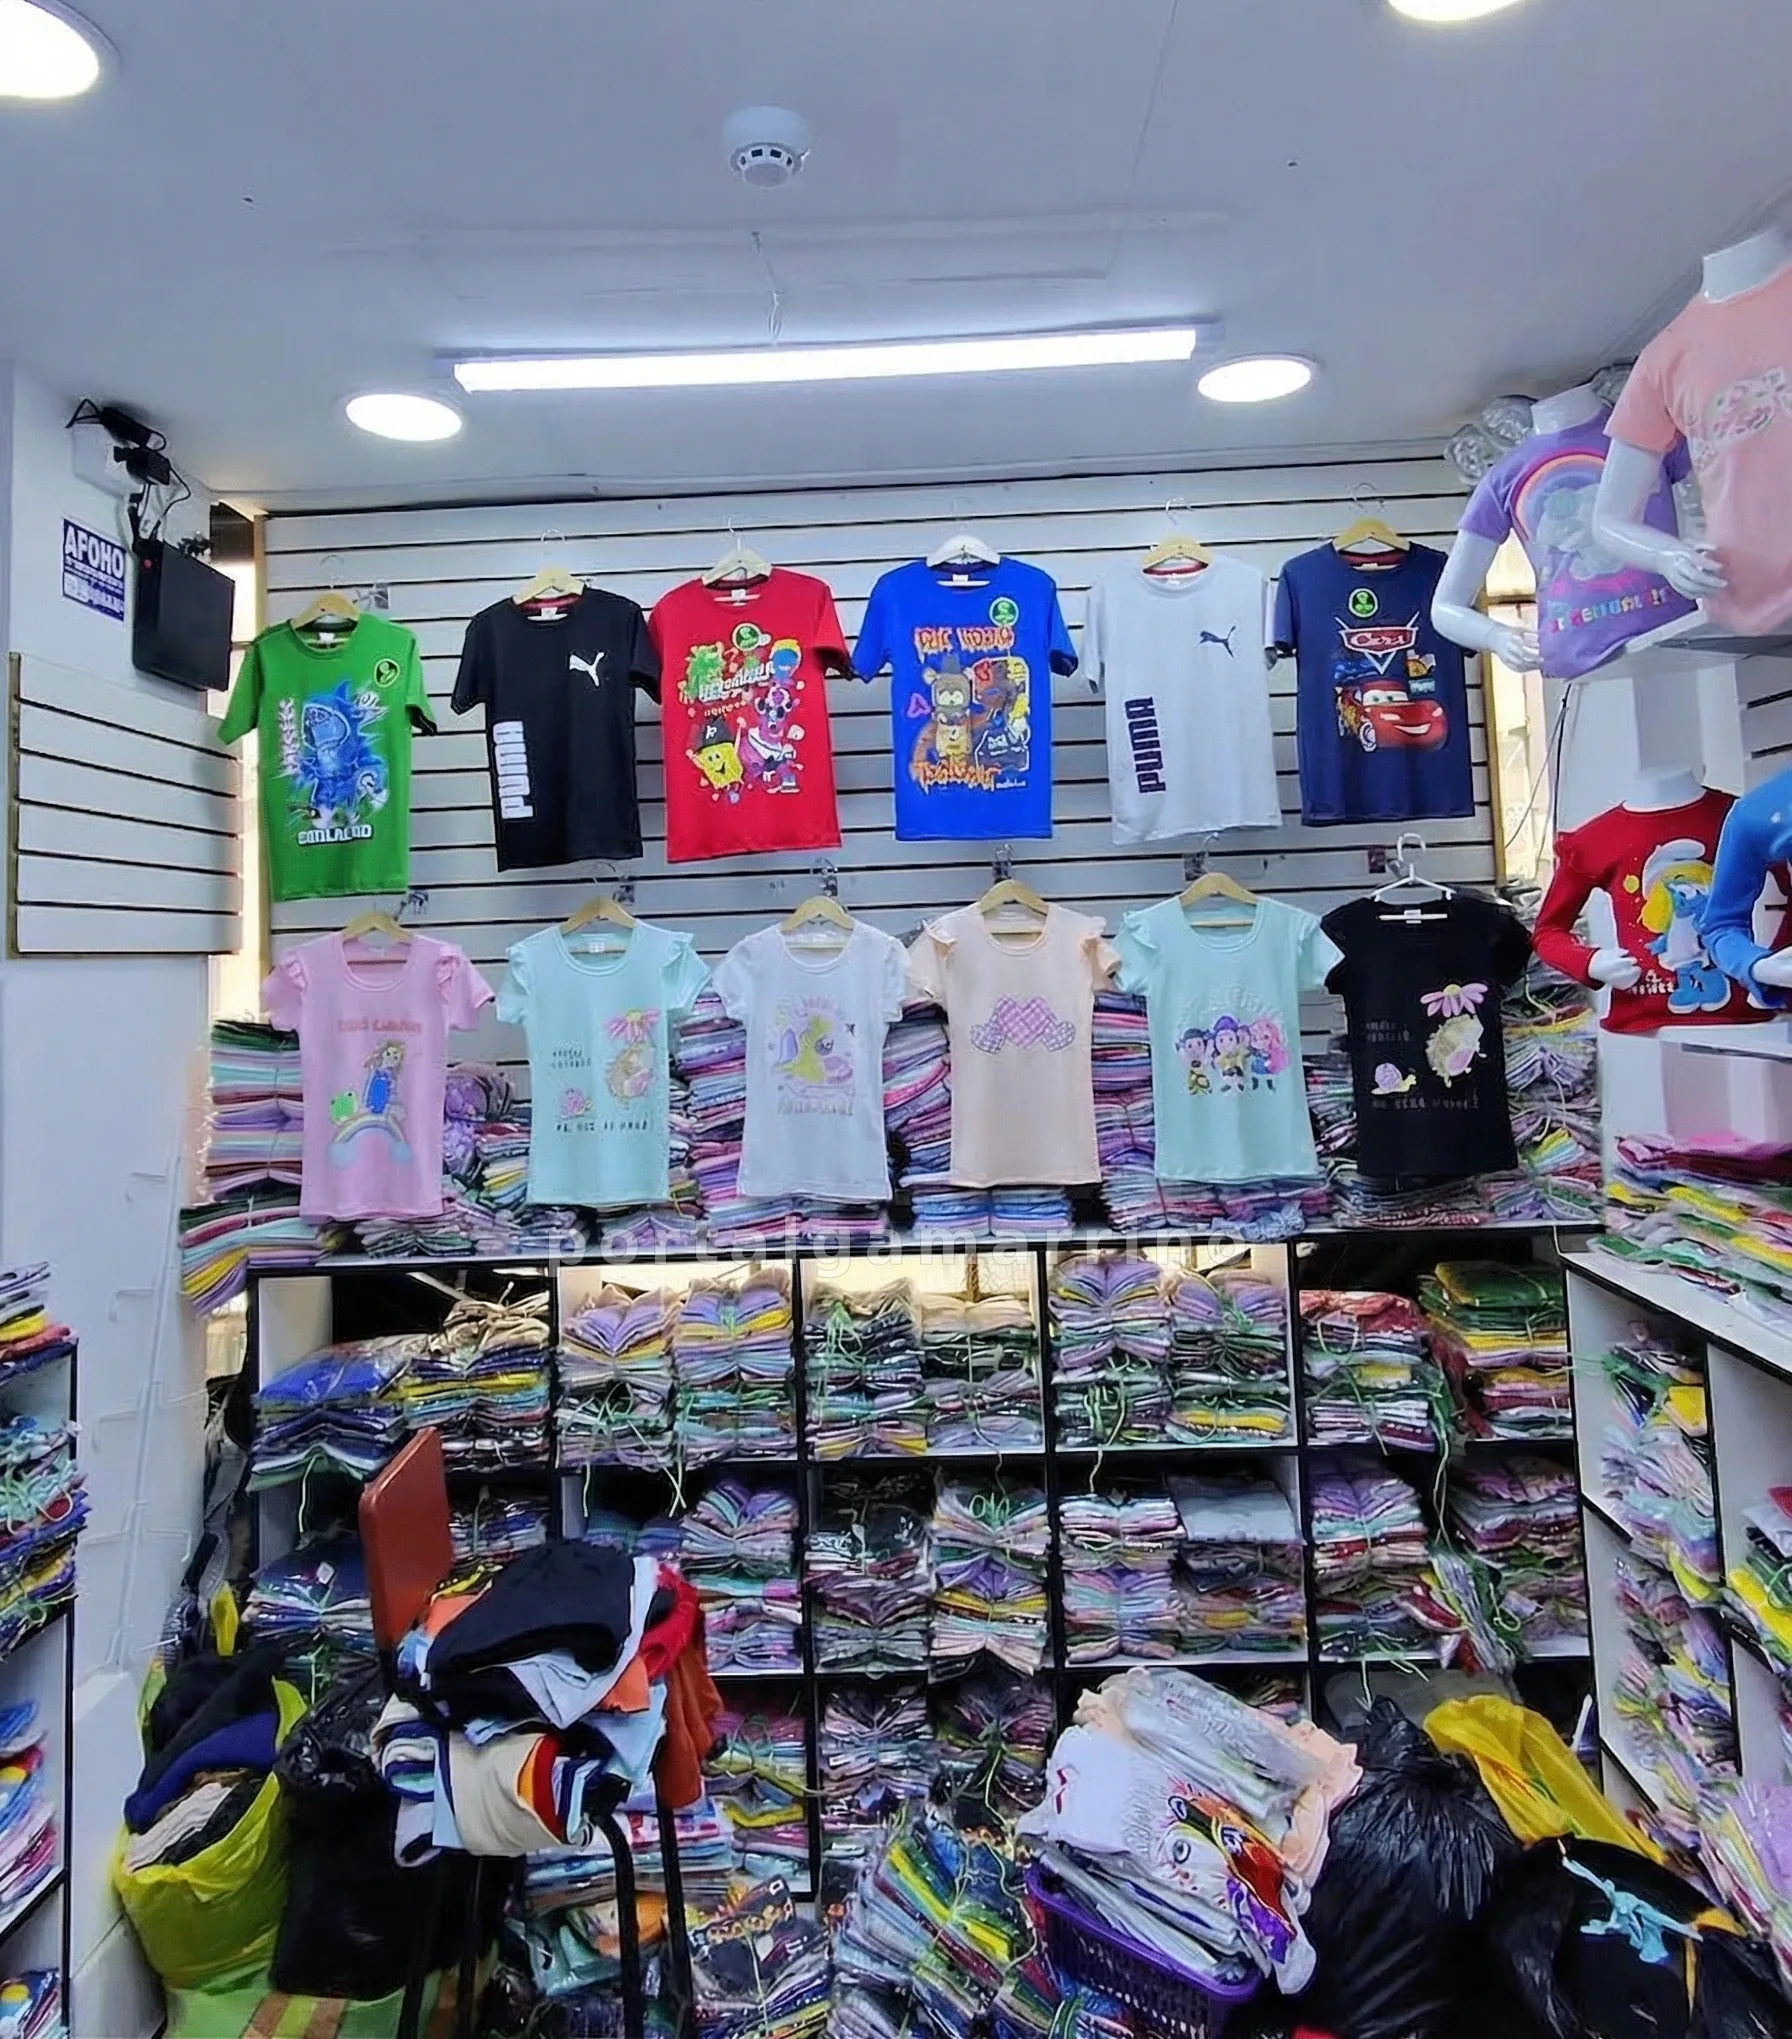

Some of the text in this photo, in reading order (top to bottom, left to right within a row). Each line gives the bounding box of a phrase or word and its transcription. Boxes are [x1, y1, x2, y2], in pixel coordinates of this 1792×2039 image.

[1350, 632, 1406, 648] Cars
[492, 720, 534, 819] PUMA
[1124, 697, 1167, 793] PUMA
